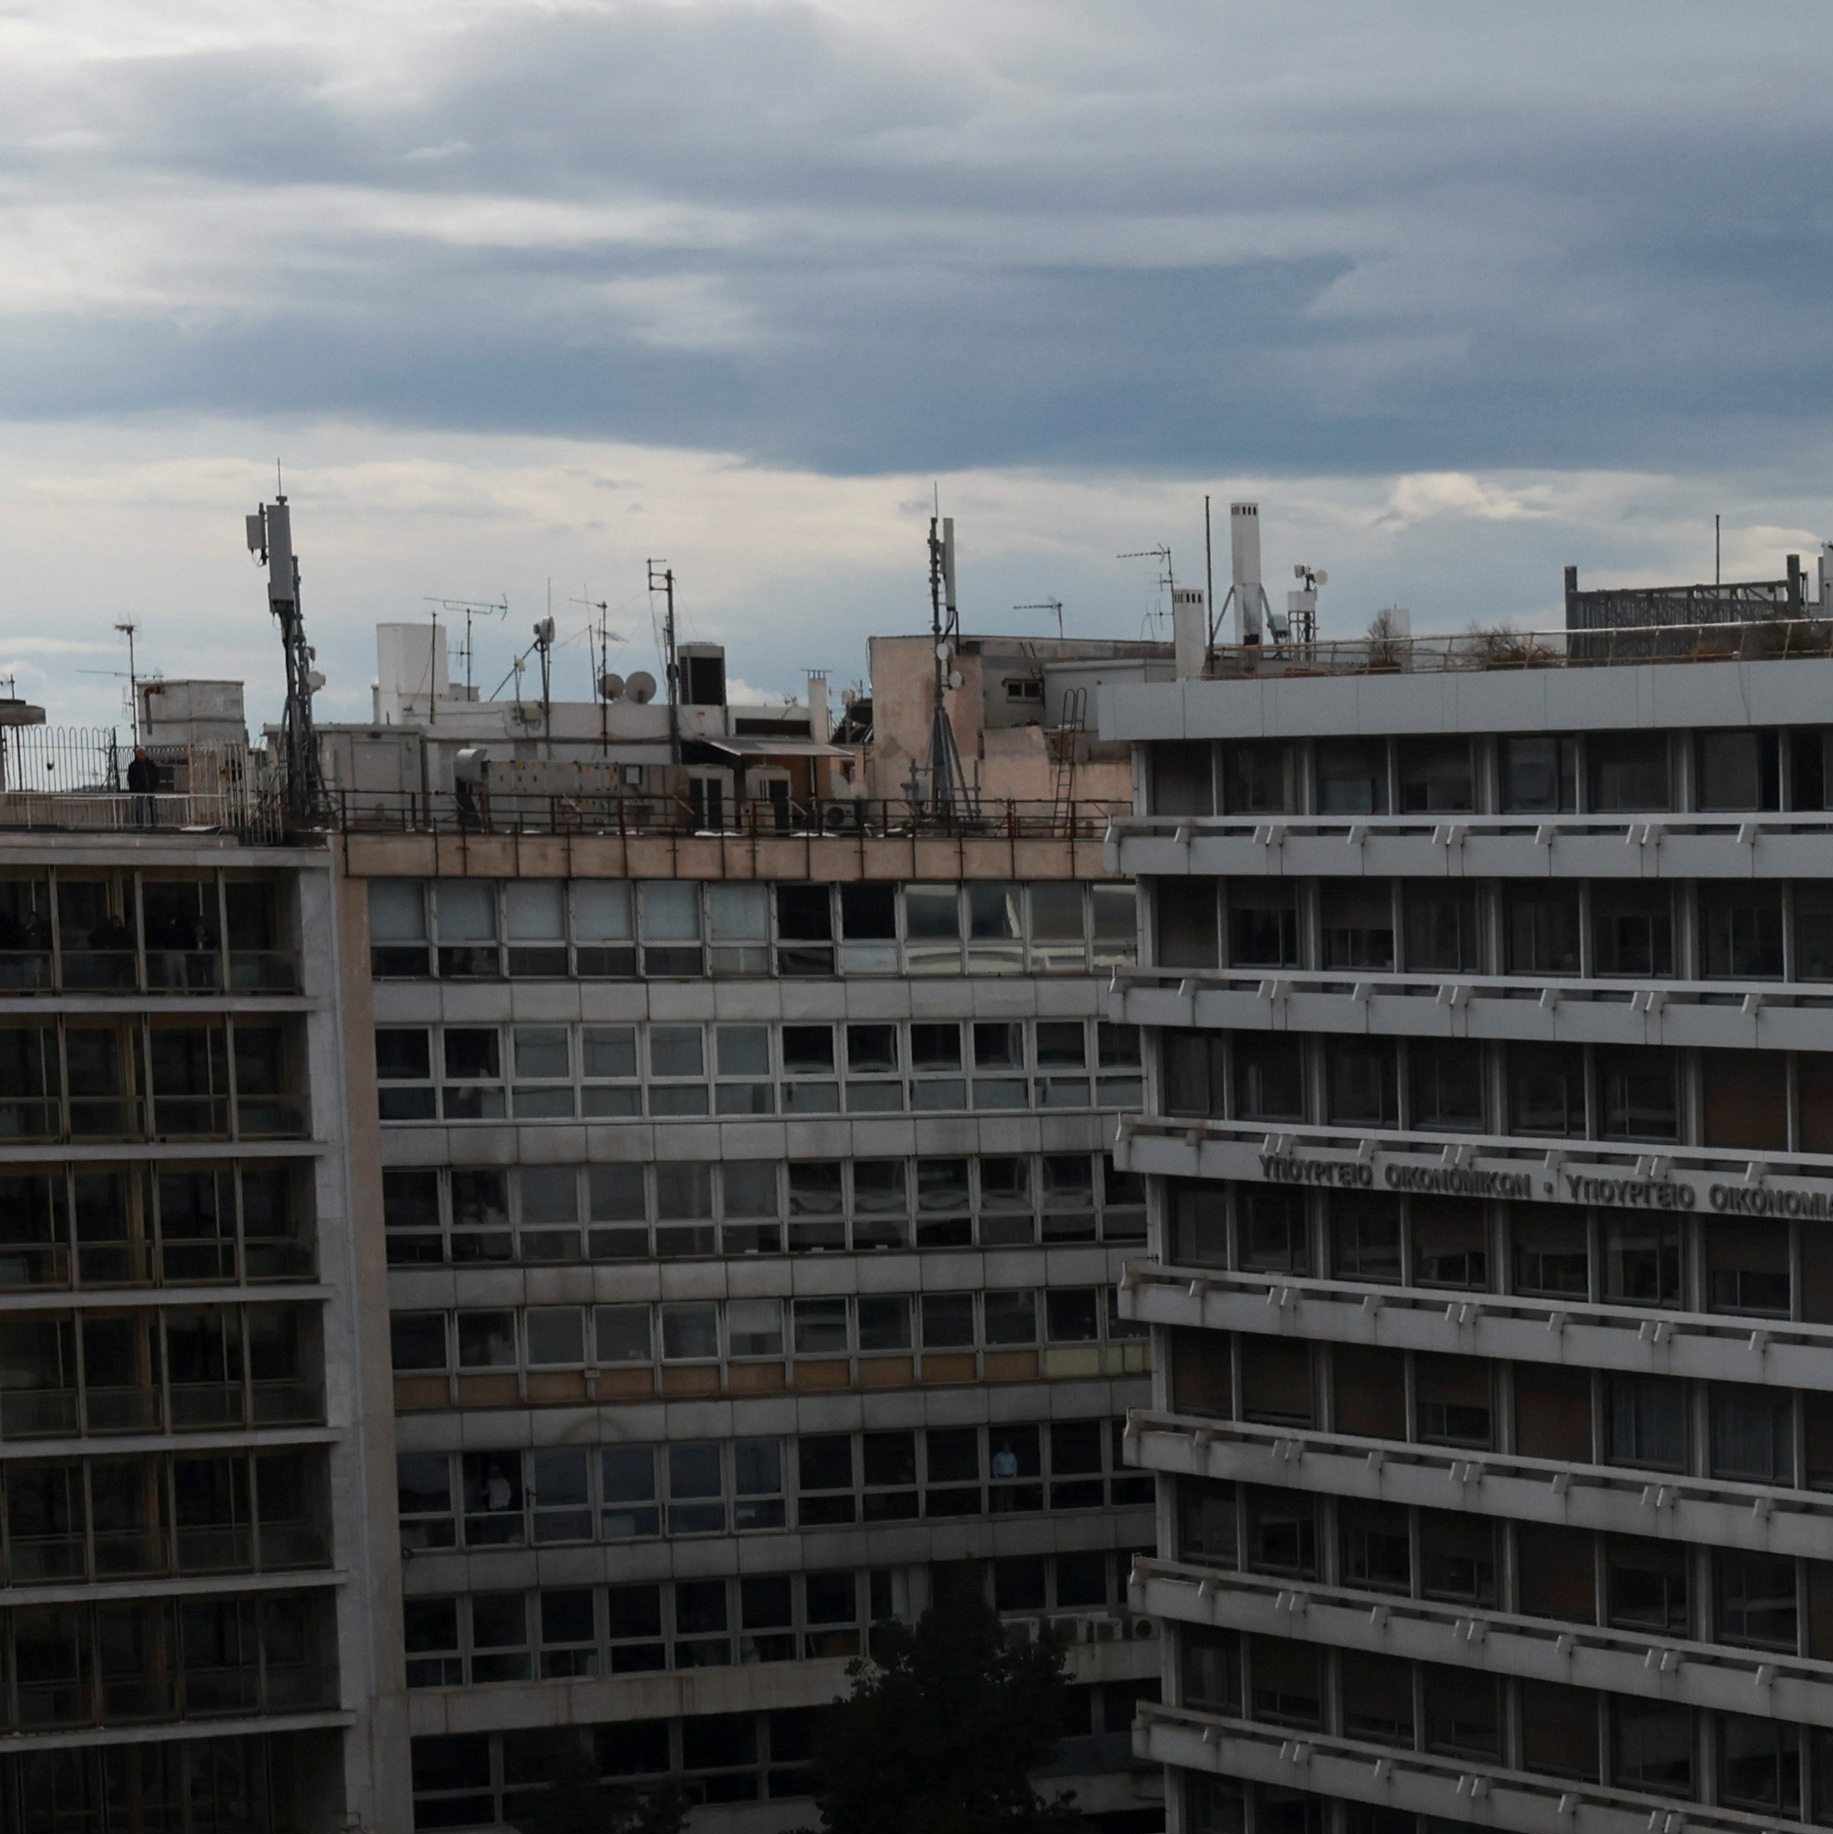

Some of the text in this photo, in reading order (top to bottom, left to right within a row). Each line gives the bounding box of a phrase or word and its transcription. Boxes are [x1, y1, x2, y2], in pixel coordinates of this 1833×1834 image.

[1259, 1155, 1373, 1187] ΥΠΟΥΡΓΕΙΟ
[1384, 1163, 1531, 1198] ΟΙΚΟΝΟΜΙΚΩΝ
[1565, 1174, 1695, 1209] ΥΠΟΥΡΓΕΙΟ
